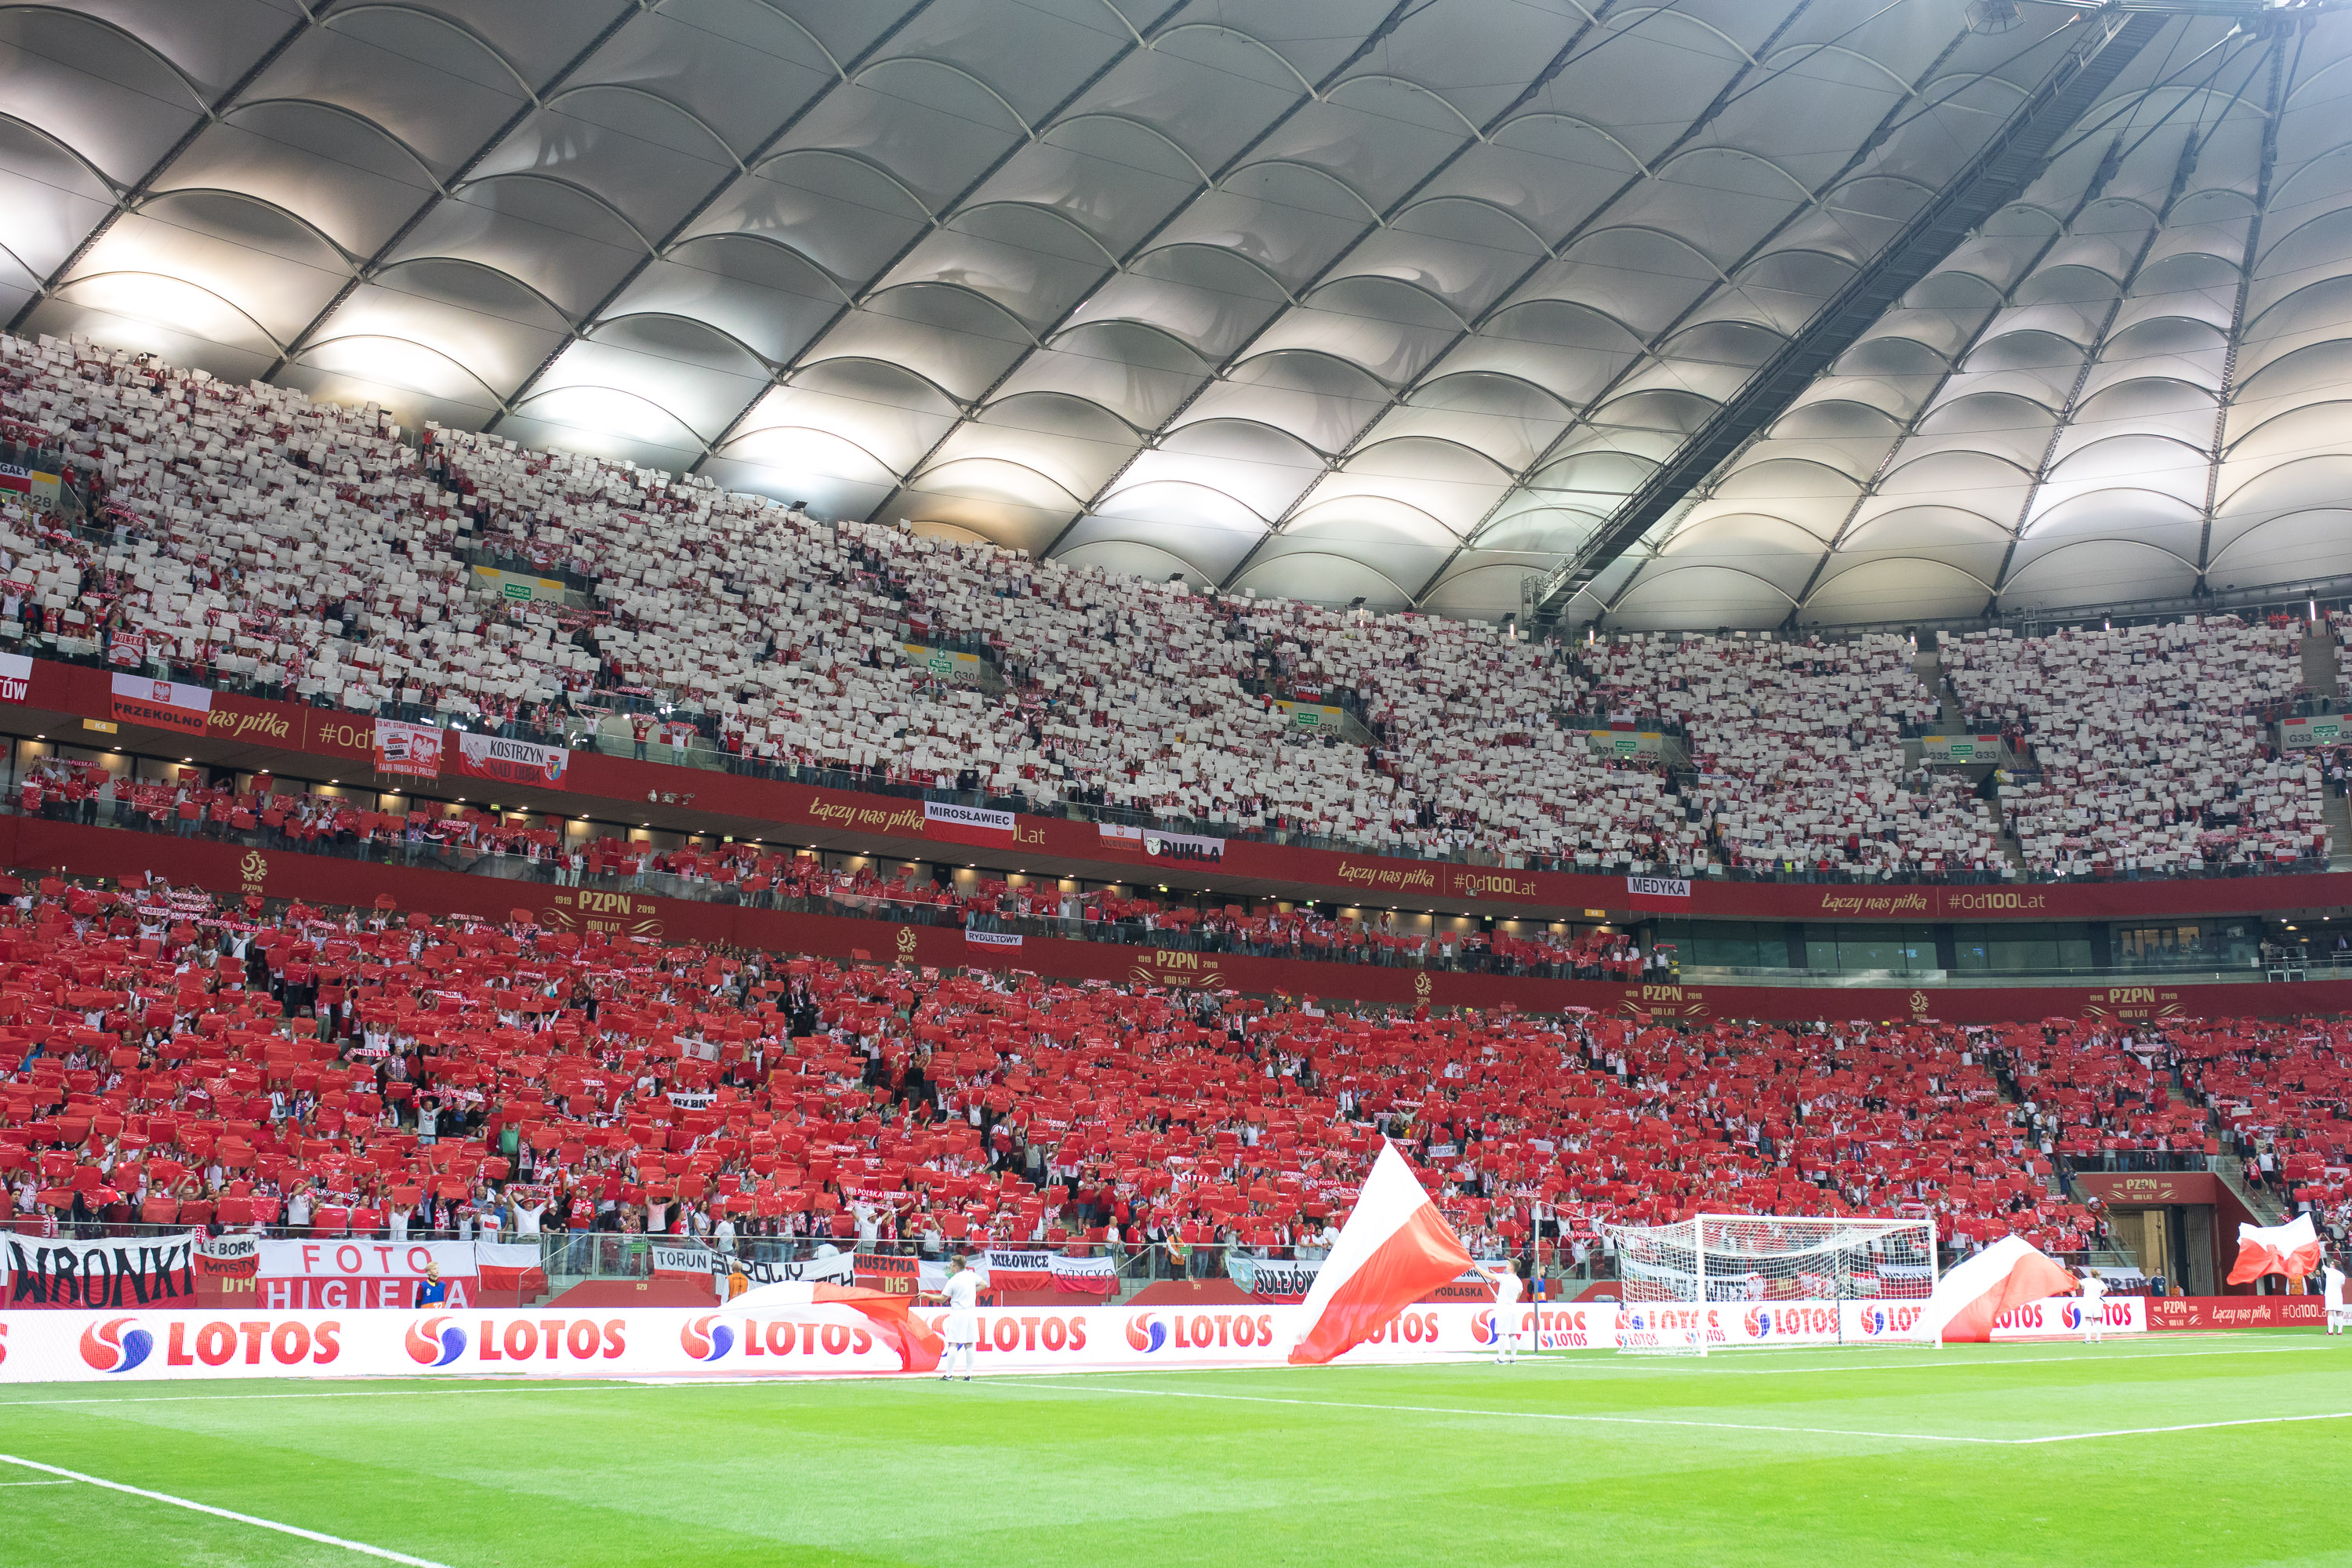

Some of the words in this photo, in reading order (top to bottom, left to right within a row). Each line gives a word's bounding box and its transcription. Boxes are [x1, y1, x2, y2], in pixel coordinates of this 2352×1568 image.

[21, 492, 52, 509] G28
[114, 633, 144, 647] POLSKA
[954, 670, 975, 681] G30
[114, 702, 203, 728] PRZEKOLNO
[95, 722, 107, 731] K4
[234, 711, 289, 738] piłka
[1320, 723, 1338, 733] G31
[2289, 734, 2312, 742] G33
[490, 740, 544, 764] KOSTRZYN
[1595, 746, 1614, 754] G31
[379, 763, 392, 771] FANI
[394, 764, 412, 773] RODEM
[489, 760, 511, 778] NAD
[808, 797, 858, 826] Łączy
[858, 809, 886, 825] nas
[883, 809, 926, 833] piłka
[929, 805, 1010, 826] MIROSŁAWIEC
[1160, 840, 1221, 863] DUKLA
[1338, 861, 1376, 886] Łączy
[1379, 869, 1401, 884] nas
[1399, 868, 1436, 889] piłka
[242, 883, 263, 893] PZPN
[1453, 873, 1537, 896] #Od100Lat
[1632, 878, 1686, 895] MEDYKA
[554, 895, 572, 906] 1919
[579, 890, 631, 915] PZPN
[637, 904, 655, 914] 2019
[1821, 892, 1862, 914] Łączy
[1865, 898, 1889, 909] nas
[1889, 893, 1927, 915] piłka
[1948, 892, 2045, 909] #Od100Lat
[232, 923, 257, 932] POLSKA
[586, 920, 603, 931] 100
[604, 922, 622, 932] LAT
[968, 931, 1018, 944] RYDUŁTOWY
[1156, 950, 1198, 970] PZPN
[1203, 960, 1218, 969] 2019
[1163, 975, 1177, 984] 100
[1642, 985, 1682, 1001] PZPN
[2109, 988, 2155, 1004] PZPN
[2126, 1178, 2158, 1190] PZPN
[857, 1188, 884, 1198] POLSKA
[302, 1244, 433, 1274] FOTO
[657, 1250, 706, 1269] TORUŃ
[853, 1255, 916, 1272] MUSZYNA
[991, 1254, 1049, 1269] MIŁOWICE
[9, 1239, 194, 1308] WRONKI
[1056, 1267, 1116, 1283] GIŻYCKO
[222, 1276, 256, 1293] D14
[884, 1276, 909, 1294] D15
[267, 1279, 468, 1308] HIGIEA
[2163, 1300, 2187, 1314] PZPN
[2212, 1305, 2235, 1323] Łączy
[2237, 1308, 2251, 1319] nas
[2251, 1305, 2271, 1324] piłka
[2281, 1304, 2327, 1319] #Od100La
[1775, 1308, 1839, 1334] LOTOS
[479, 1319, 626, 1361] LOTOS
[746, 1319, 873, 1356] LOTOS
[975, 1316, 1087, 1352] LOTOS
[1175, 1315, 1272, 1348] LOTOS
[1554, 1333, 1588, 1347] LOTOS
[167, 1320, 341, 1366] LOTOS
